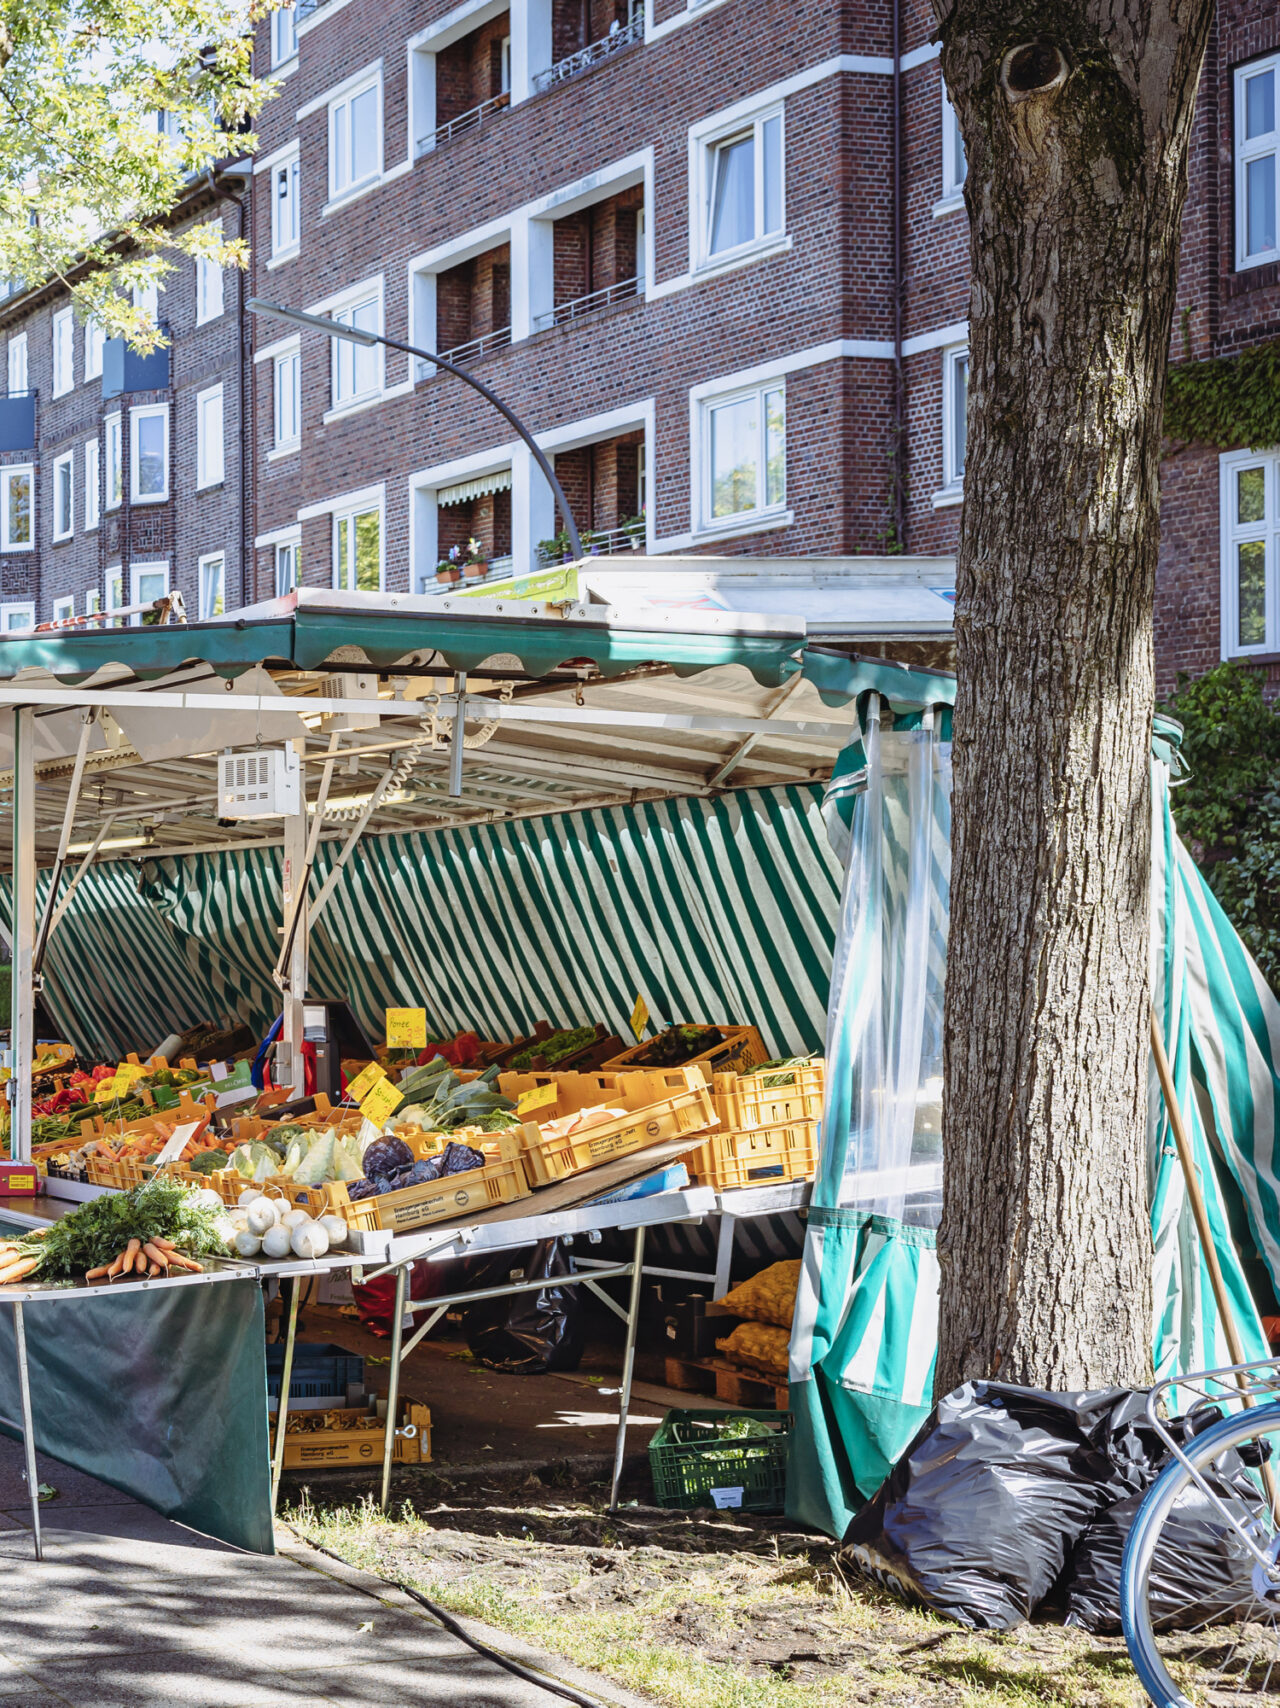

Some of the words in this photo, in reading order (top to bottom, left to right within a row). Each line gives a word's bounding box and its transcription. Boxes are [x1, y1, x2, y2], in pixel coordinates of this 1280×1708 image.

[589, 1143, 614, 1153] Hamburg
[394, 1197, 444, 1213] Erzeugergemeinschaft
[395, 1209, 420, 1219] Hamburg
